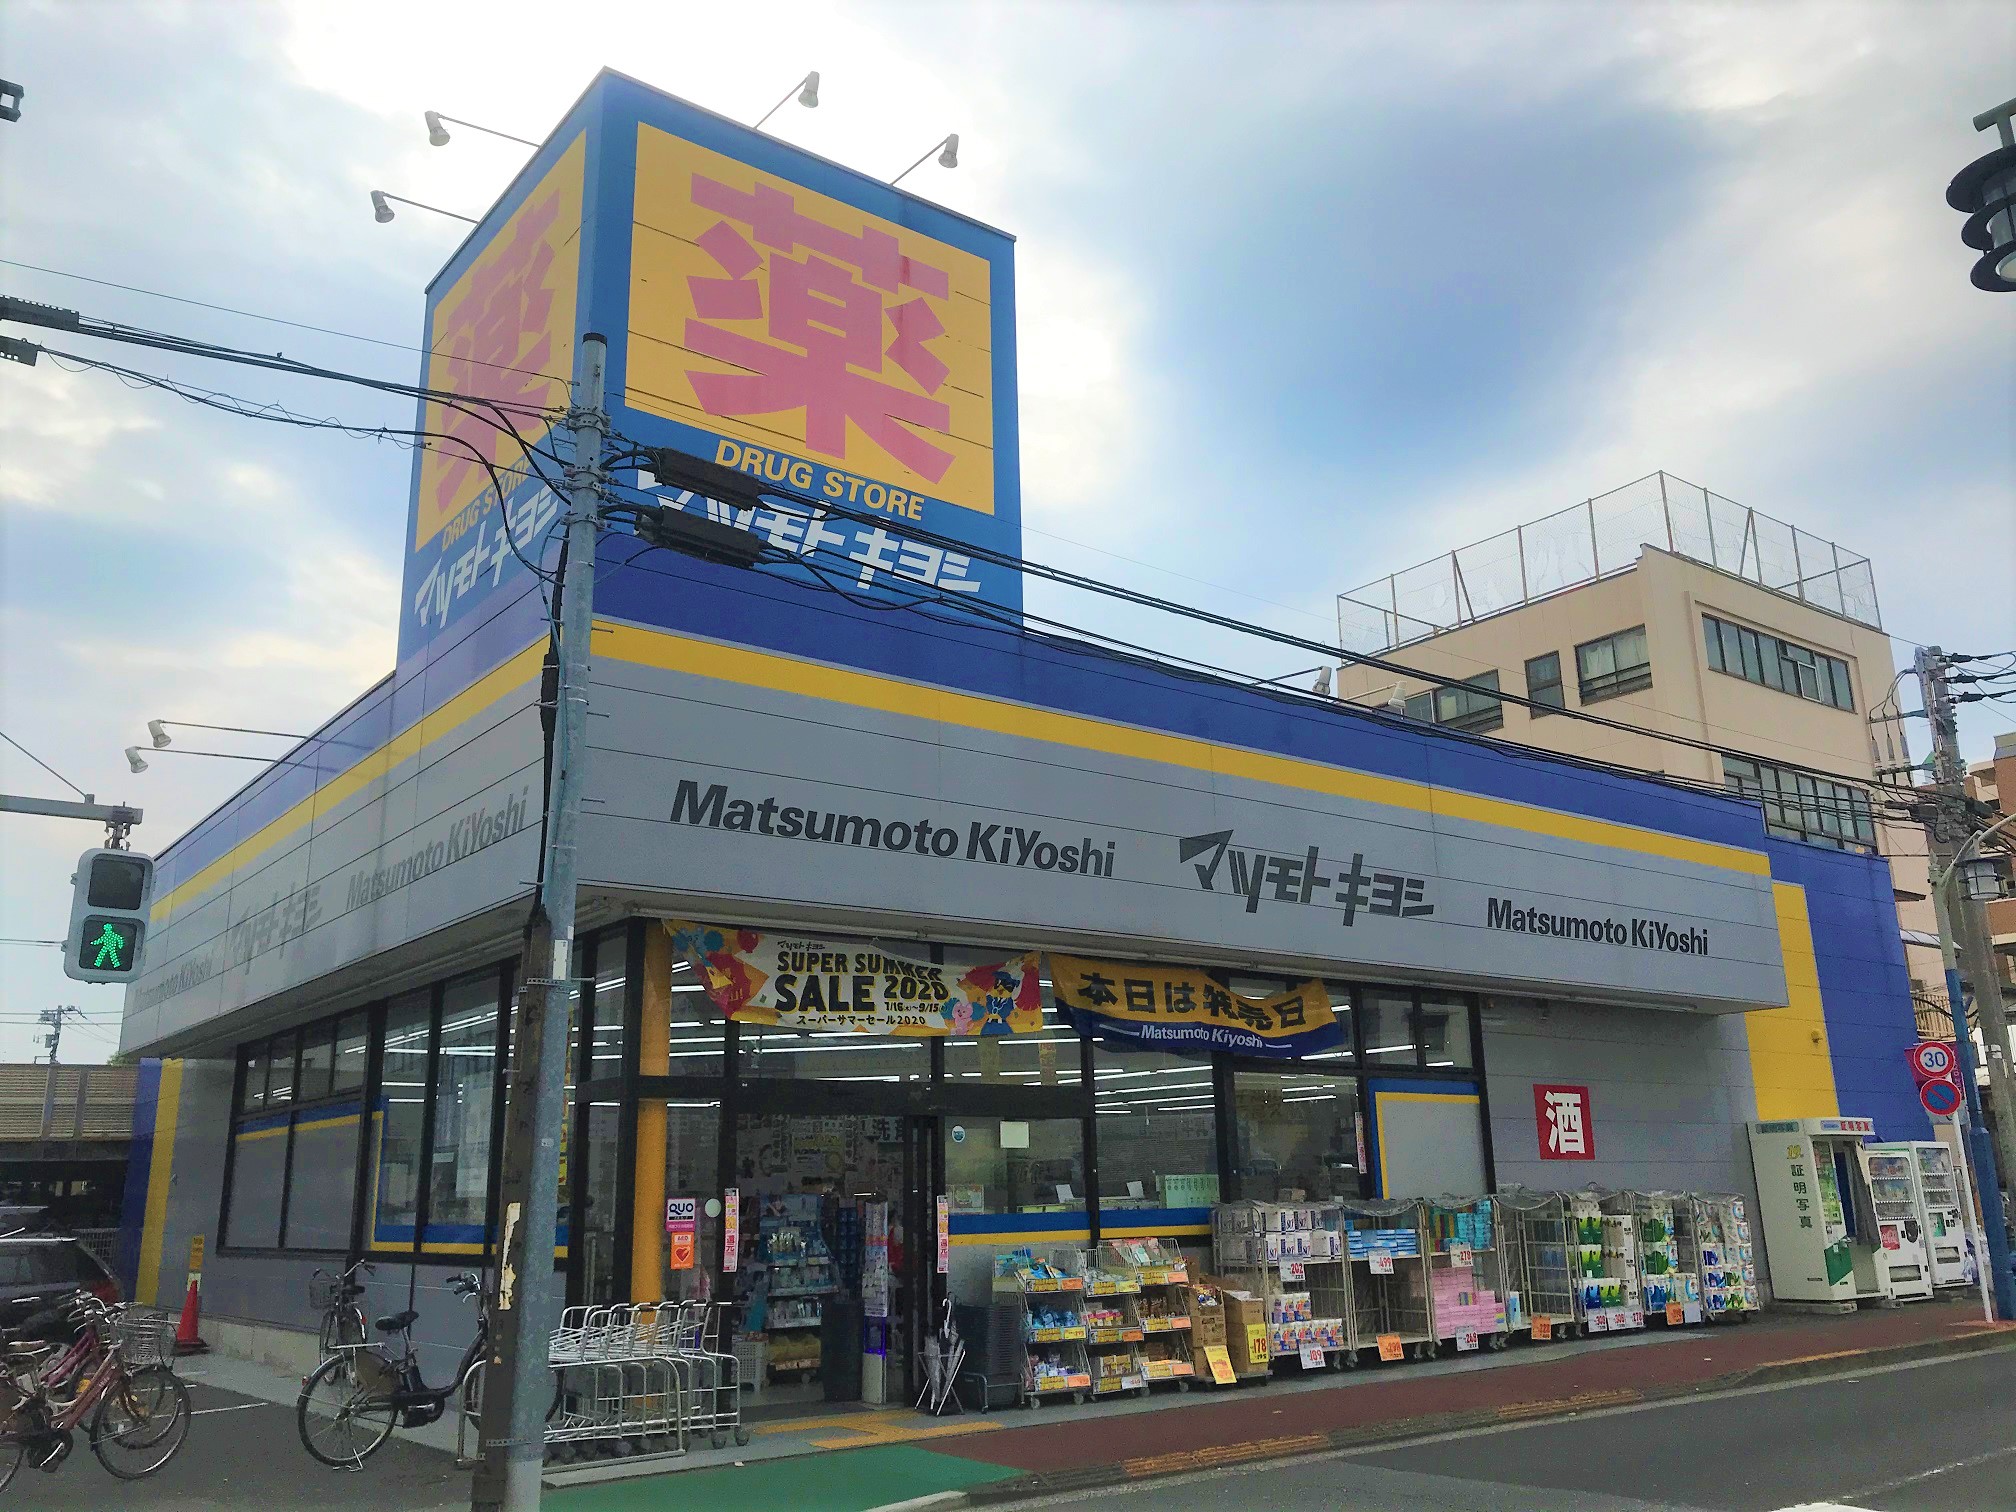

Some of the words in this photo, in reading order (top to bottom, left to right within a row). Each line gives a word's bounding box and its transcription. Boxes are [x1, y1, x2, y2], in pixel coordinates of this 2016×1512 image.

[683, 173, 954, 484] 薬
[714, 440, 812, 489] DRUG
[823, 472, 925, 521] STORE
[442, 499, 481, 552] DRUG
[414, 485, 558, 629] マツモトキヨシ
[346, 840, 444, 912] Matsumoto
[447, 785, 529, 864] KiYoshi
[669, 780, 959, 857] Matsumoto
[966, 821, 1116, 878] KiYoshi
[1179, 829, 1435, 927] マツモトキヨシ
[1487, 898, 1627, 946] Matsumoto
[1632, 919, 1709, 956] KiYoshi
[777, 952, 848, 973] SUPER
[774, 974, 875, 1013] SALE
[883, 975, 949, 1001] 2020
[796, 1014, 926, 1026] スーパーサマーセール2020
[1077, 972, 1307, 1031] 本日は特売日
[1140, 1025, 1210, 1042] Matsumoto
[1211, 1028, 1263, 1049] Kiyoshi
[1923, 1052, 1946, 1068] 30
[1544, 1090, 1585, 1154] 酒
[669, 1203, 694, 1215] QUO
[1791, 1164, 1813, 1228] 証明写真
[1290, 1262, 1303, 1275] 202
[1253, 1338, 1267, 1354] 178
